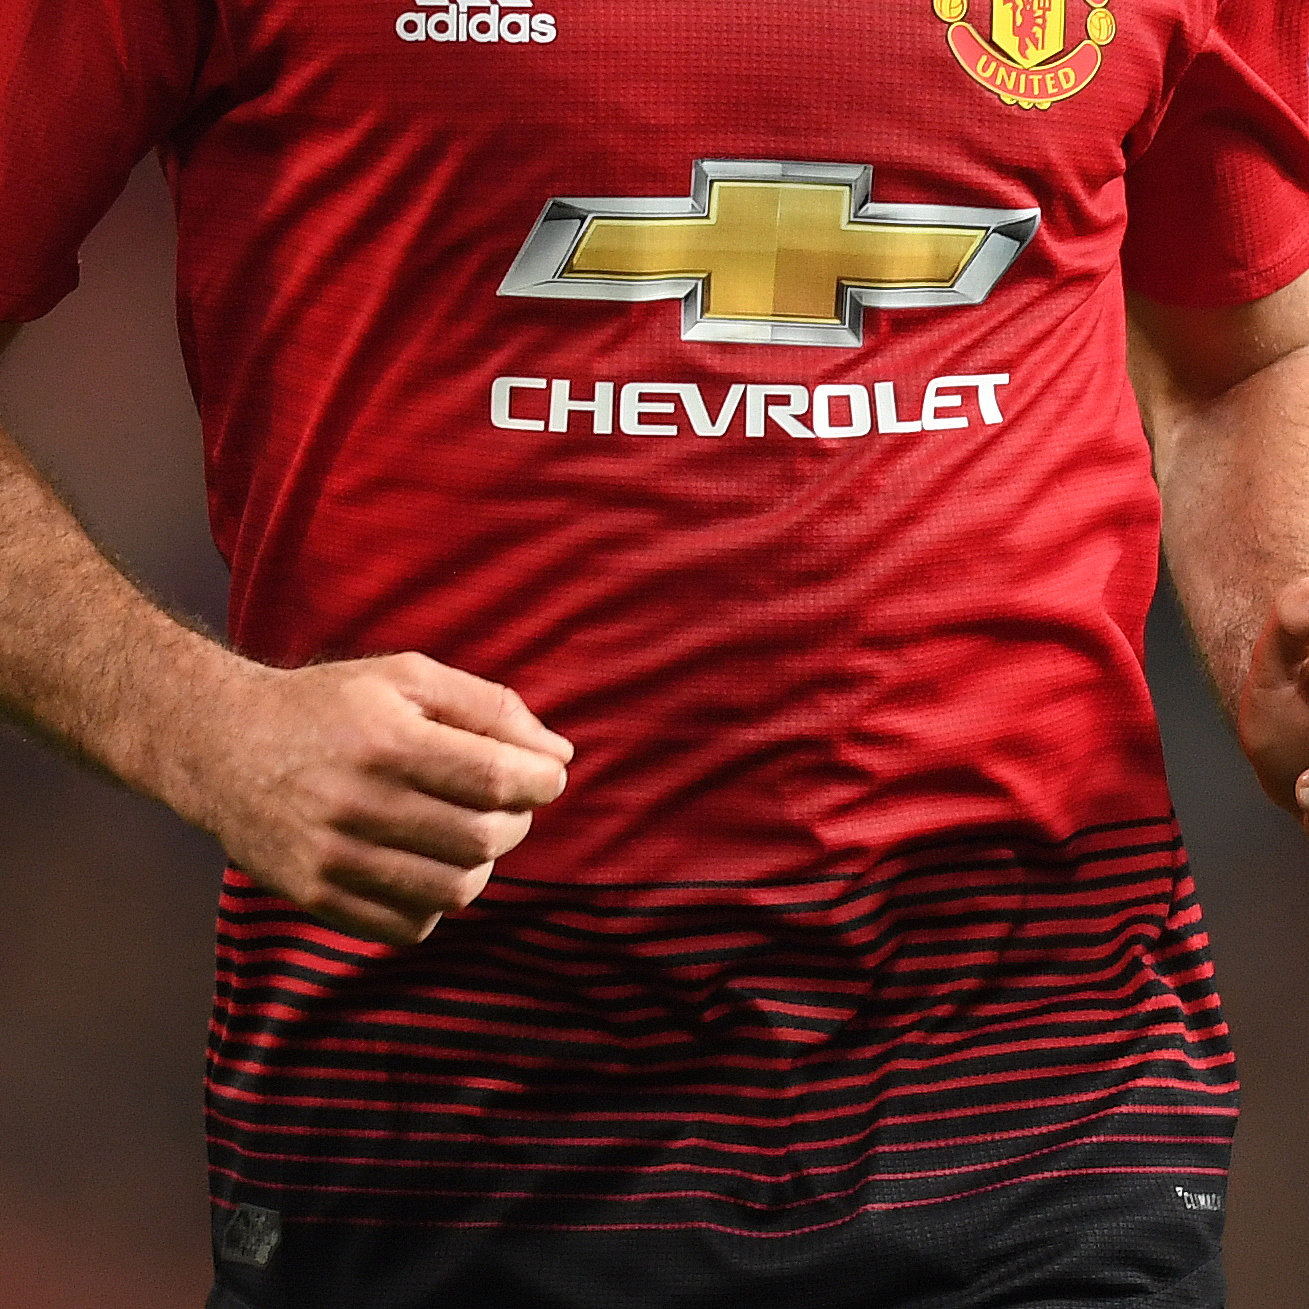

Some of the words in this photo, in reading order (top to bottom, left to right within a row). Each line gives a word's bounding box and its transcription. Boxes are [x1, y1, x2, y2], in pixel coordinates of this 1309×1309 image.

[395, 3, 557, 43] adidas
[976, 55, 1076, 96] UNITED
[491, 373, 1010, 438] CHEVROLET
